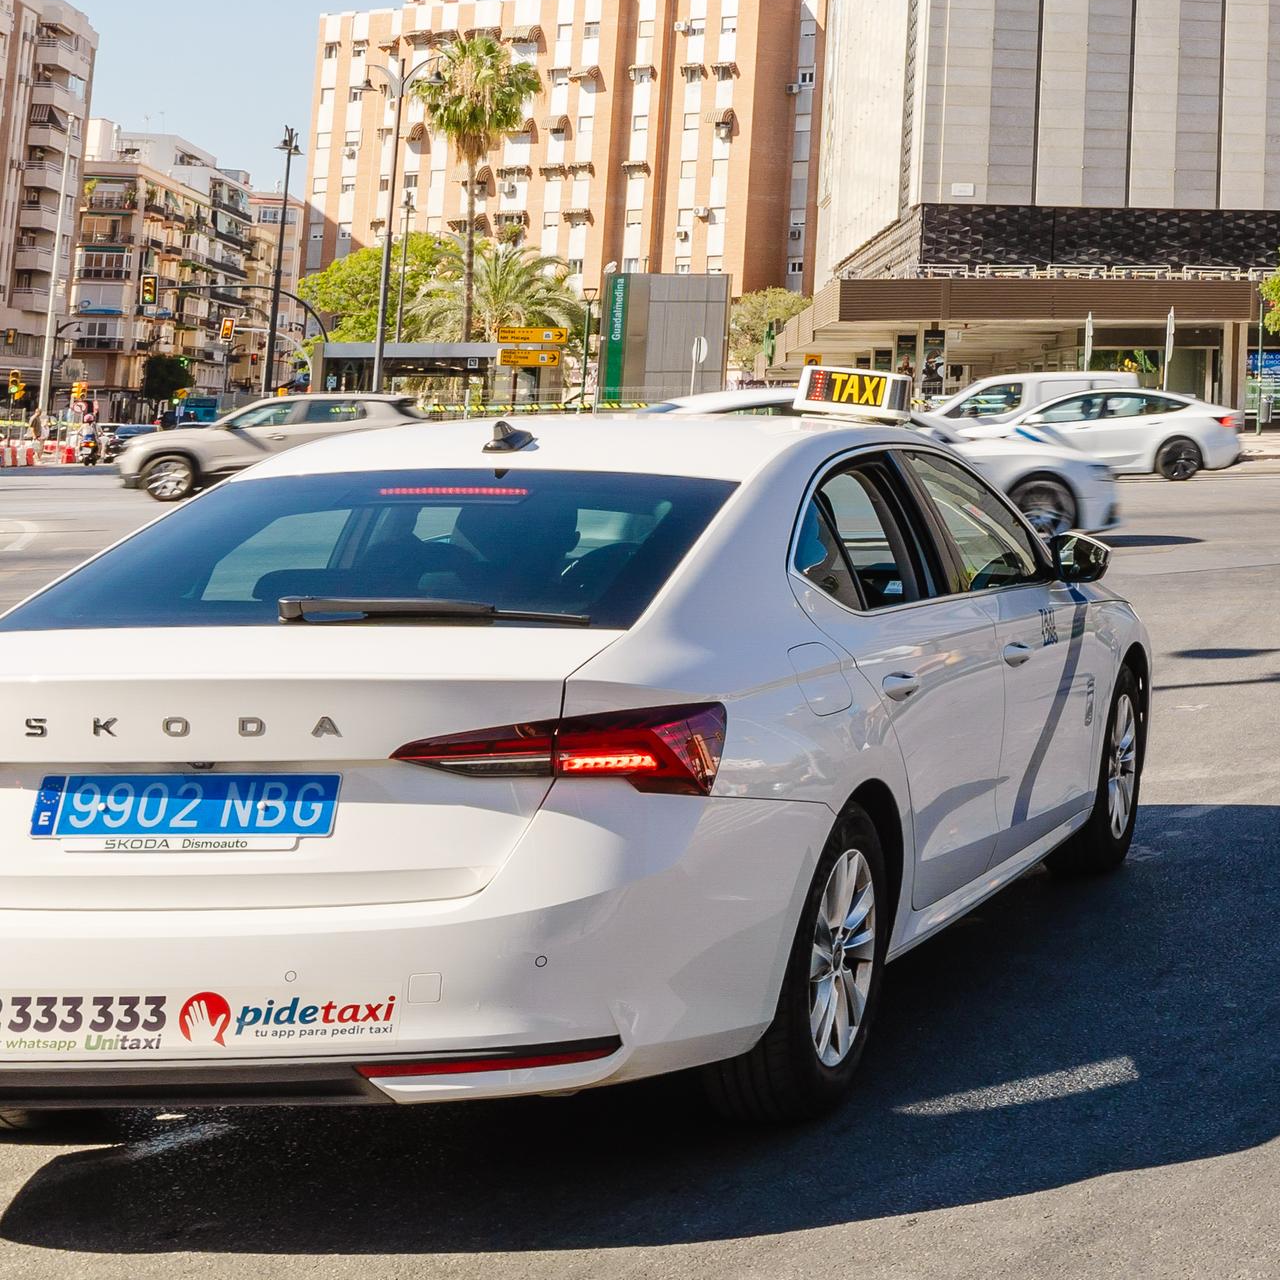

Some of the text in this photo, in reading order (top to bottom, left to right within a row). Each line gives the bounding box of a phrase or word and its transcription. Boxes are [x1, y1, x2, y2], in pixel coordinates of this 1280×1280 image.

[611, 278, 625, 341] Guadalmedina
[831, 373, 888, 406] TAXI
[25, 716, 343, 738] SKODA
[38, 781, 326, 829] E 9902 NBG
[104, 838, 248, 850] SKODA Dismoauto
[8, 996, 84, 1033] 333
[89, 996, 167, 1033] 333
[235, 995, 396, 1036] pidetaxi
[255, 1024, 393, 1038] tu app para pedir taxi
[5, 1033, 162, 1052] whatsapp Unitaxi
